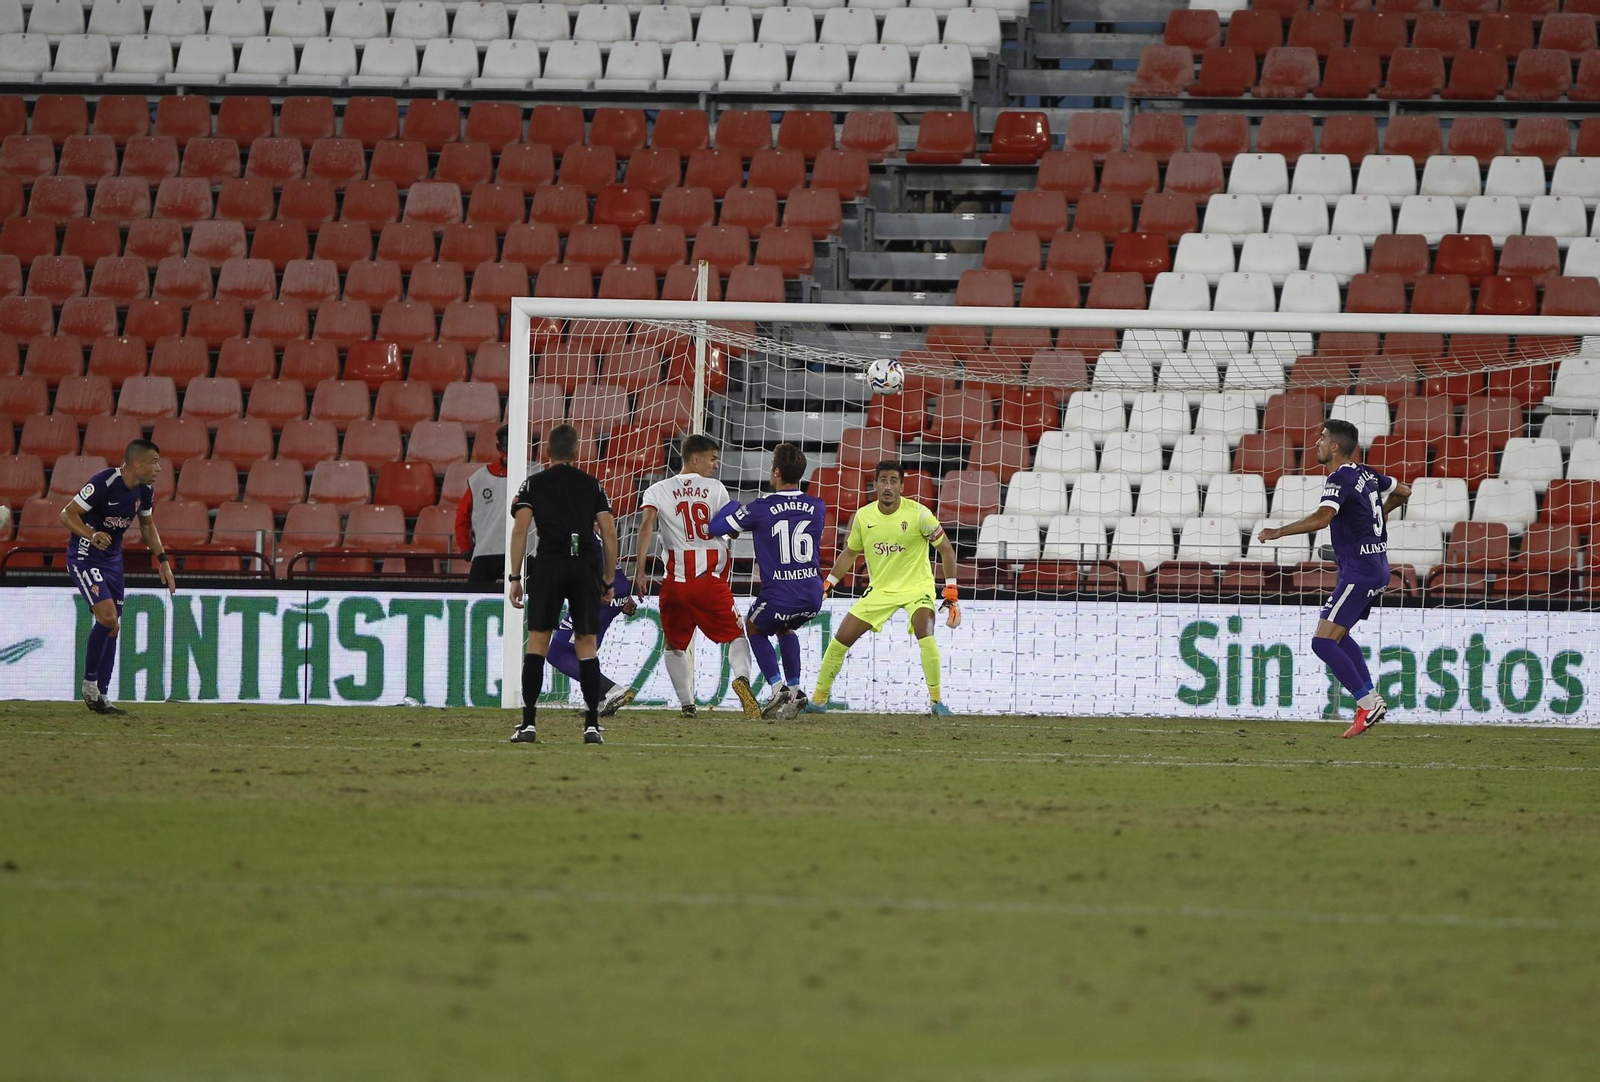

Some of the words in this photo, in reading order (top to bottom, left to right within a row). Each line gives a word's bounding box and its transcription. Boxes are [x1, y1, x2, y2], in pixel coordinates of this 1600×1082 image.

[674, 500, 714, 542] 18
[769, 501, 816, 516] GRAGERA
[1368, 490, 1384, 537] 5
[771, 519, 814, 565] 16
[82, 567, 104, 587] 18
[772, 567, 819, 581] ALIMERKA
[73, 594, 569, 707] ANTÁSTIC
[1177, 615, 1294, 707] Sin
